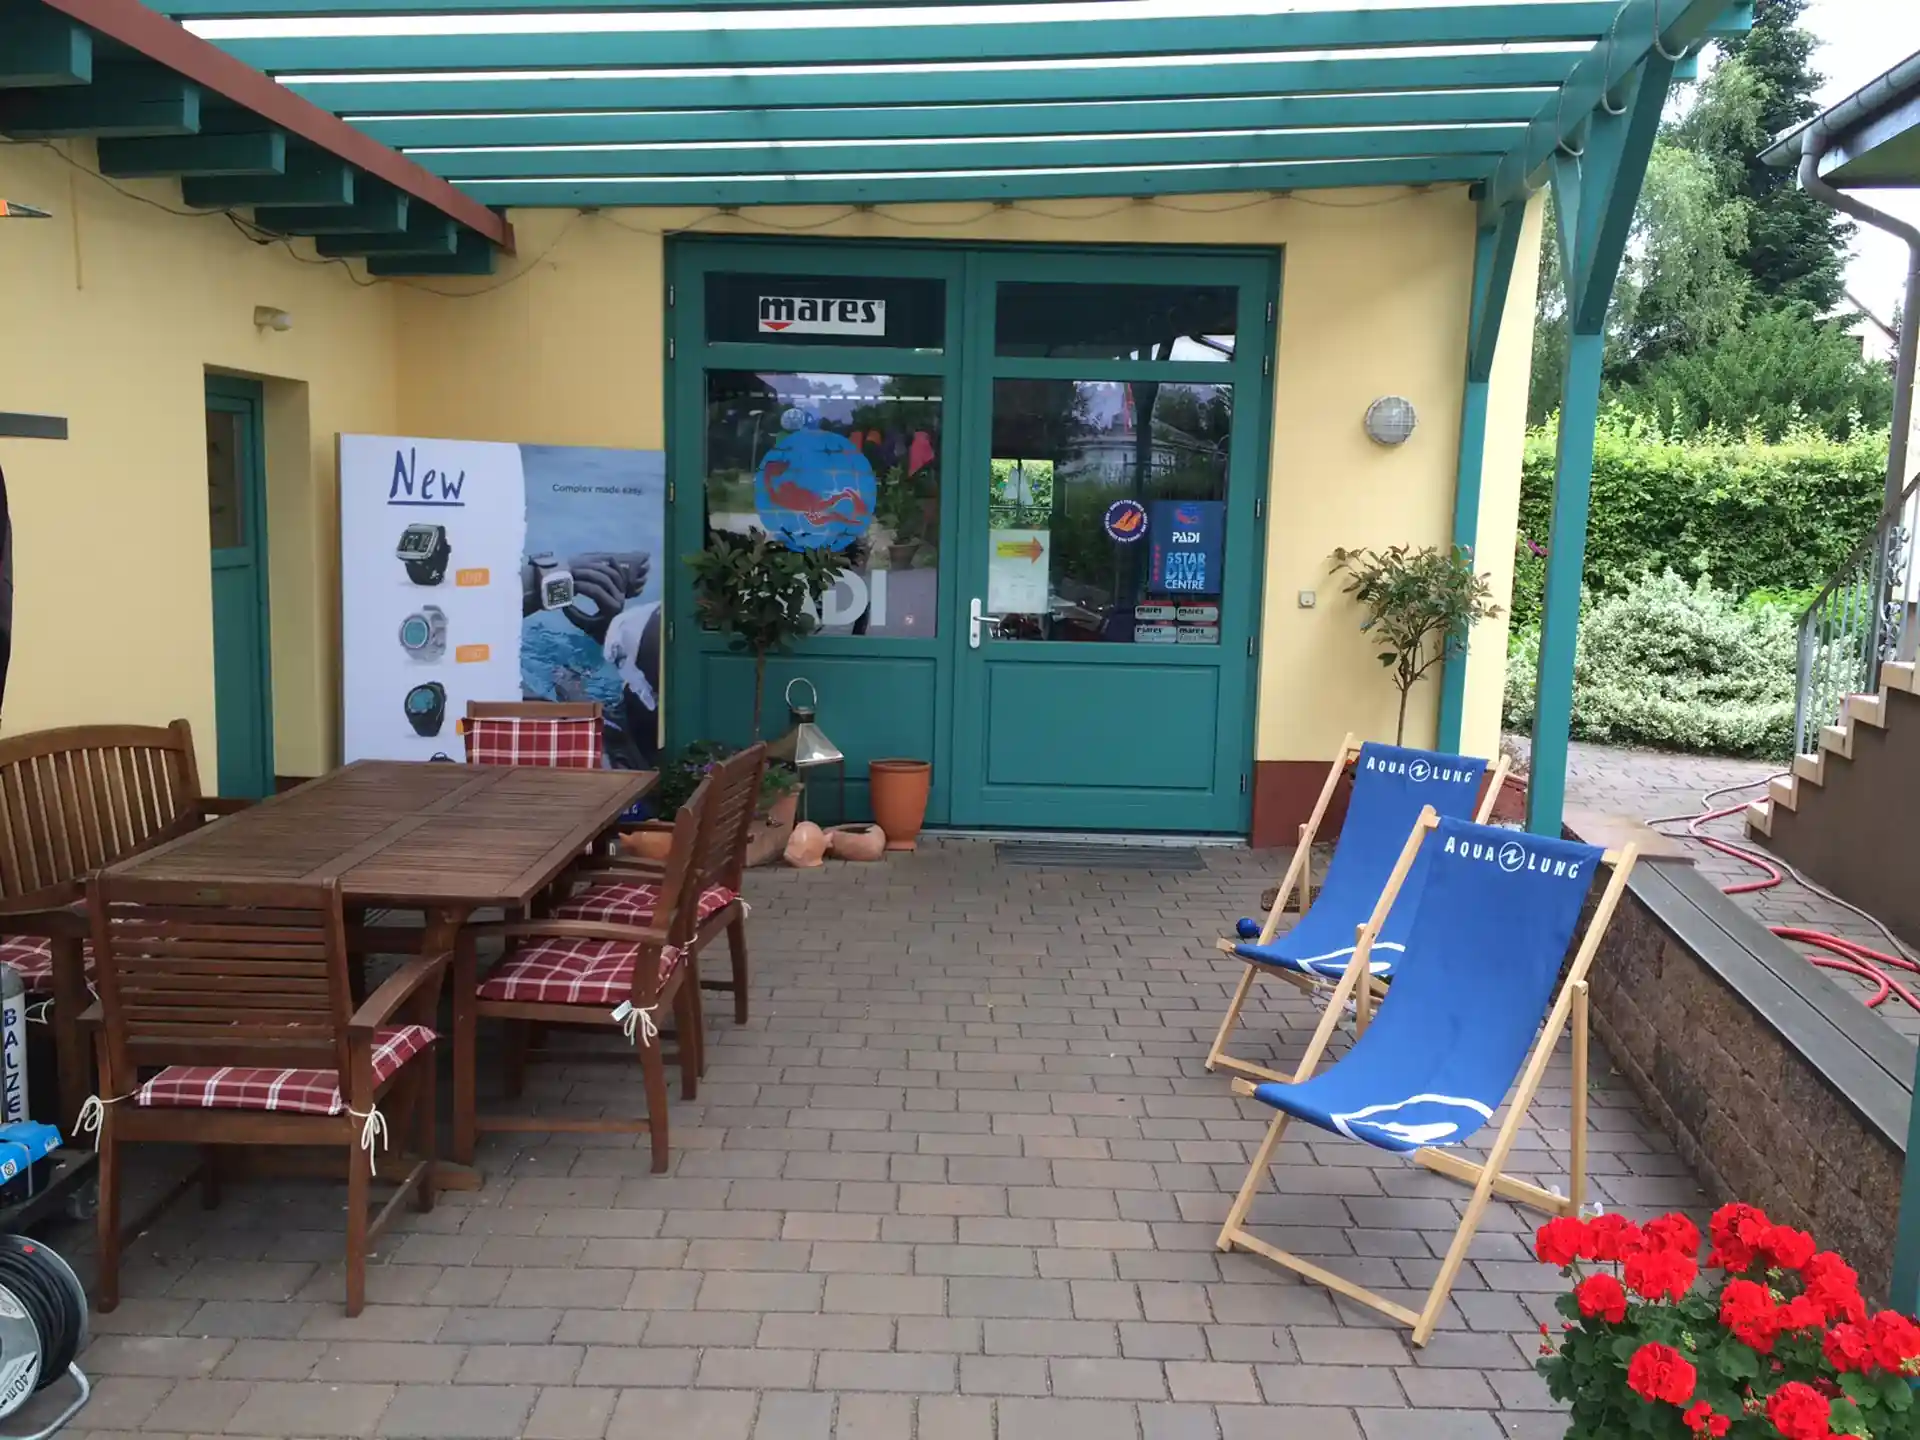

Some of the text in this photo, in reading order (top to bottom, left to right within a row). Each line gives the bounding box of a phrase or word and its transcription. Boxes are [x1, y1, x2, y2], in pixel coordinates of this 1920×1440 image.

[389, 447, 465, 500] New
[552, 484, 592, 493] Complex
[595, 486, 620, 494] made
[1172, 532, 1201, 543] PADI
[1165, 564, 1205, 581] DIVE
[1165, 580, 1205, 590] CENTRE
[1366, 756, 1472, 783] AQUA LUNG
[1444, 836, 1580, 880] AQUA LUNG
[4, 1008, 23, 1124] BALZE
